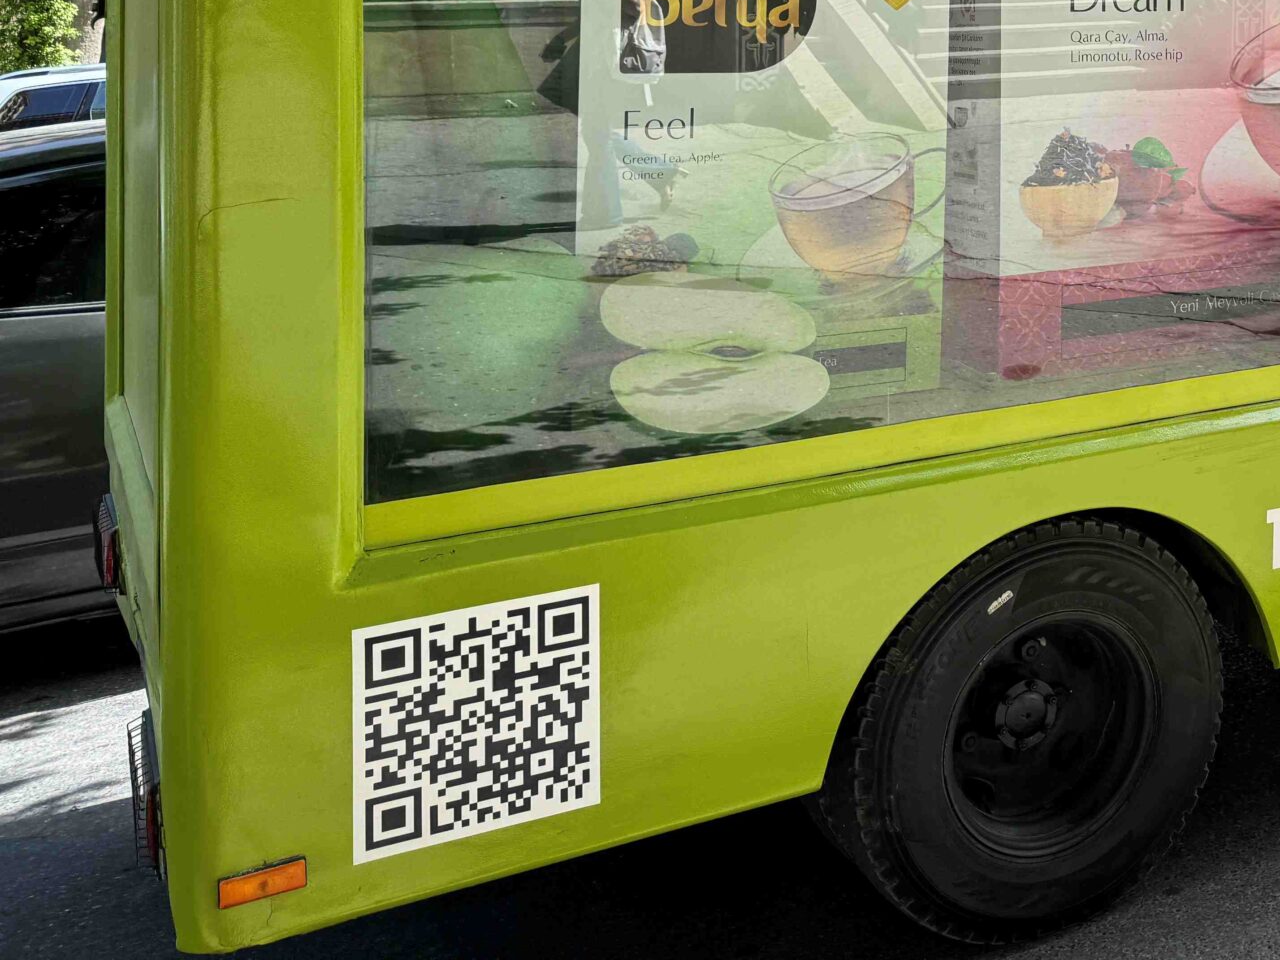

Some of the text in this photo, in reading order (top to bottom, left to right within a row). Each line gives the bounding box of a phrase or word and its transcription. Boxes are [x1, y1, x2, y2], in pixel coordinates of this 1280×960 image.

[1070, 29, 1168, 45] Qara Çay, Alma,
[1070, 50, 1132, 63] Limonotu,
[623, 107, 695, 141] Feel
[622, 154, 658, 165] Green
[622, 170, 664, 182] Quince
[1170, 298, 1199, 314] Yeni
